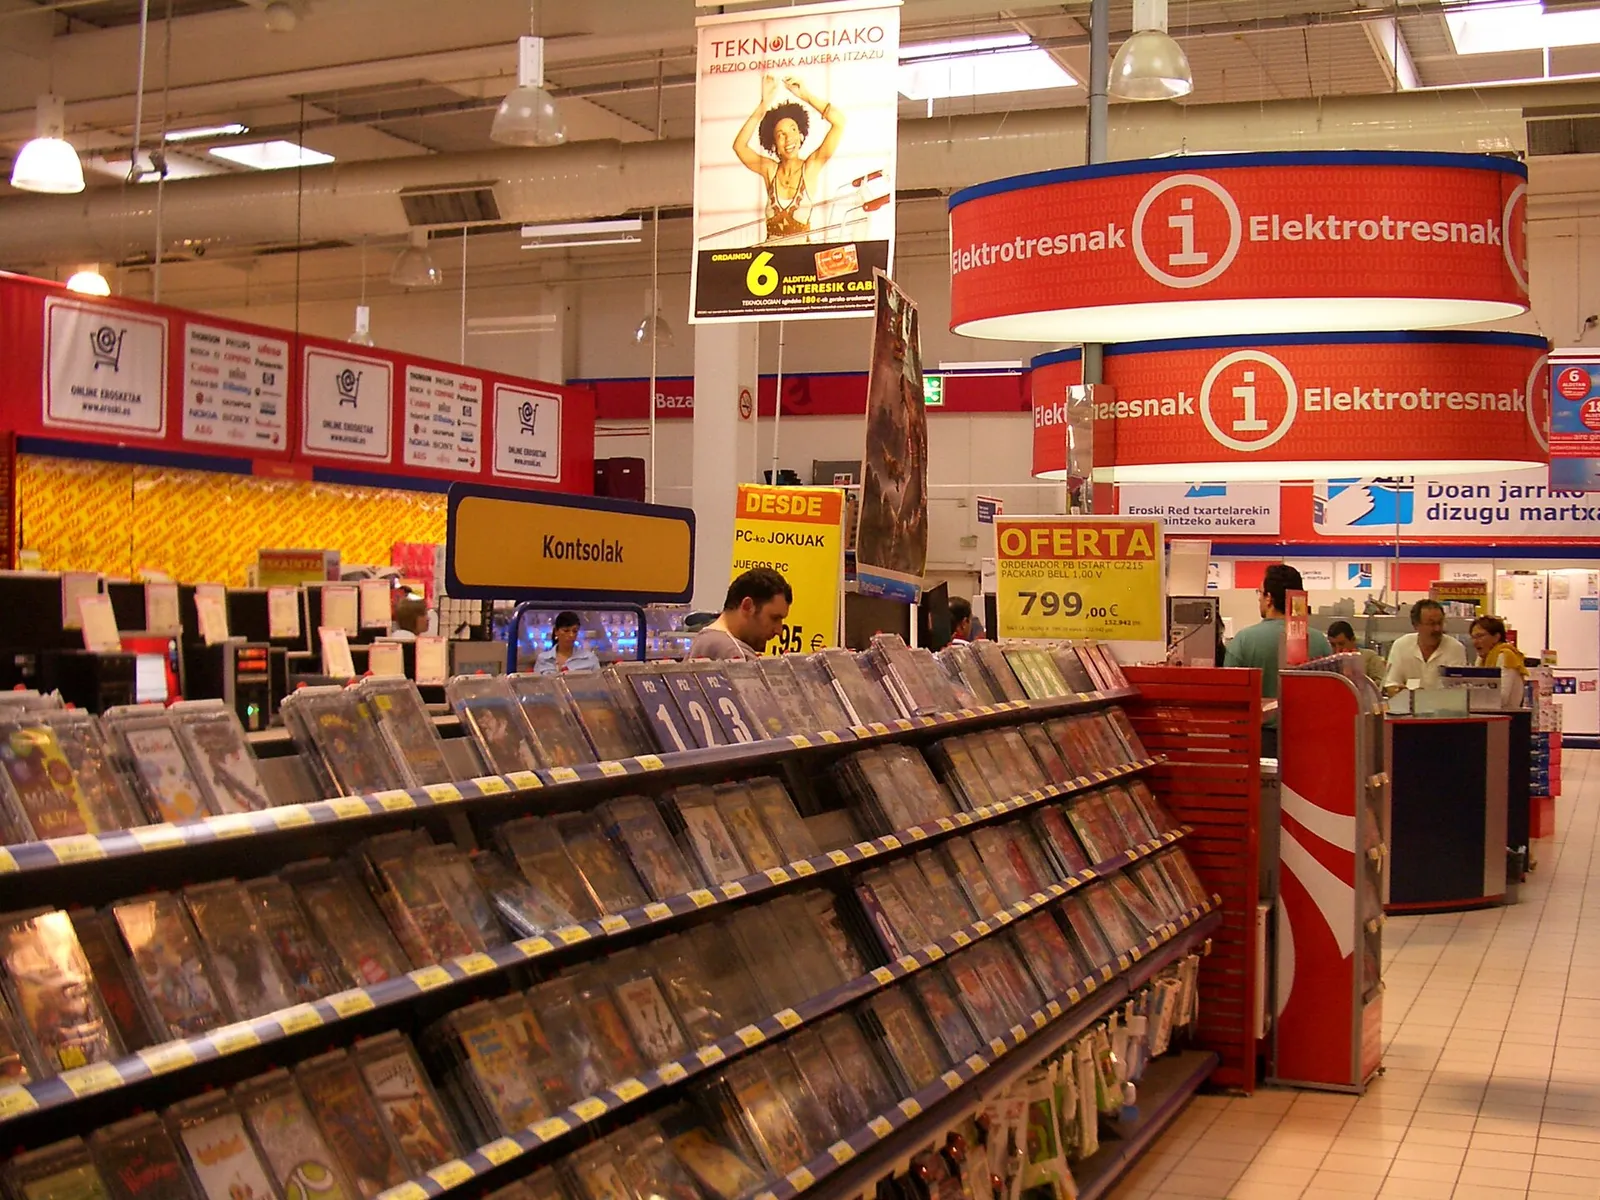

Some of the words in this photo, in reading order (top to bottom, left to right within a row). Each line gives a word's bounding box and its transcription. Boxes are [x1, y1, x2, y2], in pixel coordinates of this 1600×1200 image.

[711, 26, 884, 58] TEKNOLOGIAKO
[710, 61, 746, 75] PREZIO
[749, 57, 795, 70] ONENAK
[798, 53, 840, 66] AUKERA
[843, 50, 885, 62] ITZAZU
[1249, 213, 1502, 246] Elektrotresnak
[712, 252, 752, 262] ORDAINDU
[952, 223, 1125, 275] Elektrotresnak
[746, 251, 779, 297] 6
[782, 275, 817, 284] ALDITAN
[782, 282, 844, 295] INTERESIK
[1569, 370, 1580, 382] 6
[656, 393, 694, 408] Baza
[1304, 387, 1526, 413] Elektrotresnak
[1427, 481, 1490, 498] Doan
[746, 492, 822, 517] DESDE
[1129, 505, 1164, 515] Eroski
[1168, 506, 1189, 515] Red
[1194, 505, 1270, 515] txartelarekin
[1164, 517, 1211, 526] aintzeko
[1215, 517, 1256, 526] aukera
[1426, 503, 1510, 525] dizugu
[1520, 504, 1600, 521] martx
[735, 530, 765, 544] PC-ko
[767, 532, 825, 547] JOKUAK
[1000, 528, 1152, 558] OFERTA
[542, 534, 624, 563] Kontsolak
[733, 560, 772, 570] JUEGOS
[775, 562, 789, 572] PC
[1001, 560, 1060, 569] ORDENADOR
[1062, 561, 1075, 569] PB
[1078, 561, 1111, 570] ISTART
[1114, 561, 1143, 570] C7215
[1001, 569, 1044, 578] PACKARD
[1047, 570, 1069, 579] BELL
[1096, 571, 1103, 579] V
[810, 633, 825, 650] €
[642, 680, 657, 693] PS2
[676, 679, 690, 691] PS2
[706, 676, 721, 688] PS2
[656, 703, 687, 751] 1
[688, 700, 722, 748] 2
[719, 697, 753, 743] 3
